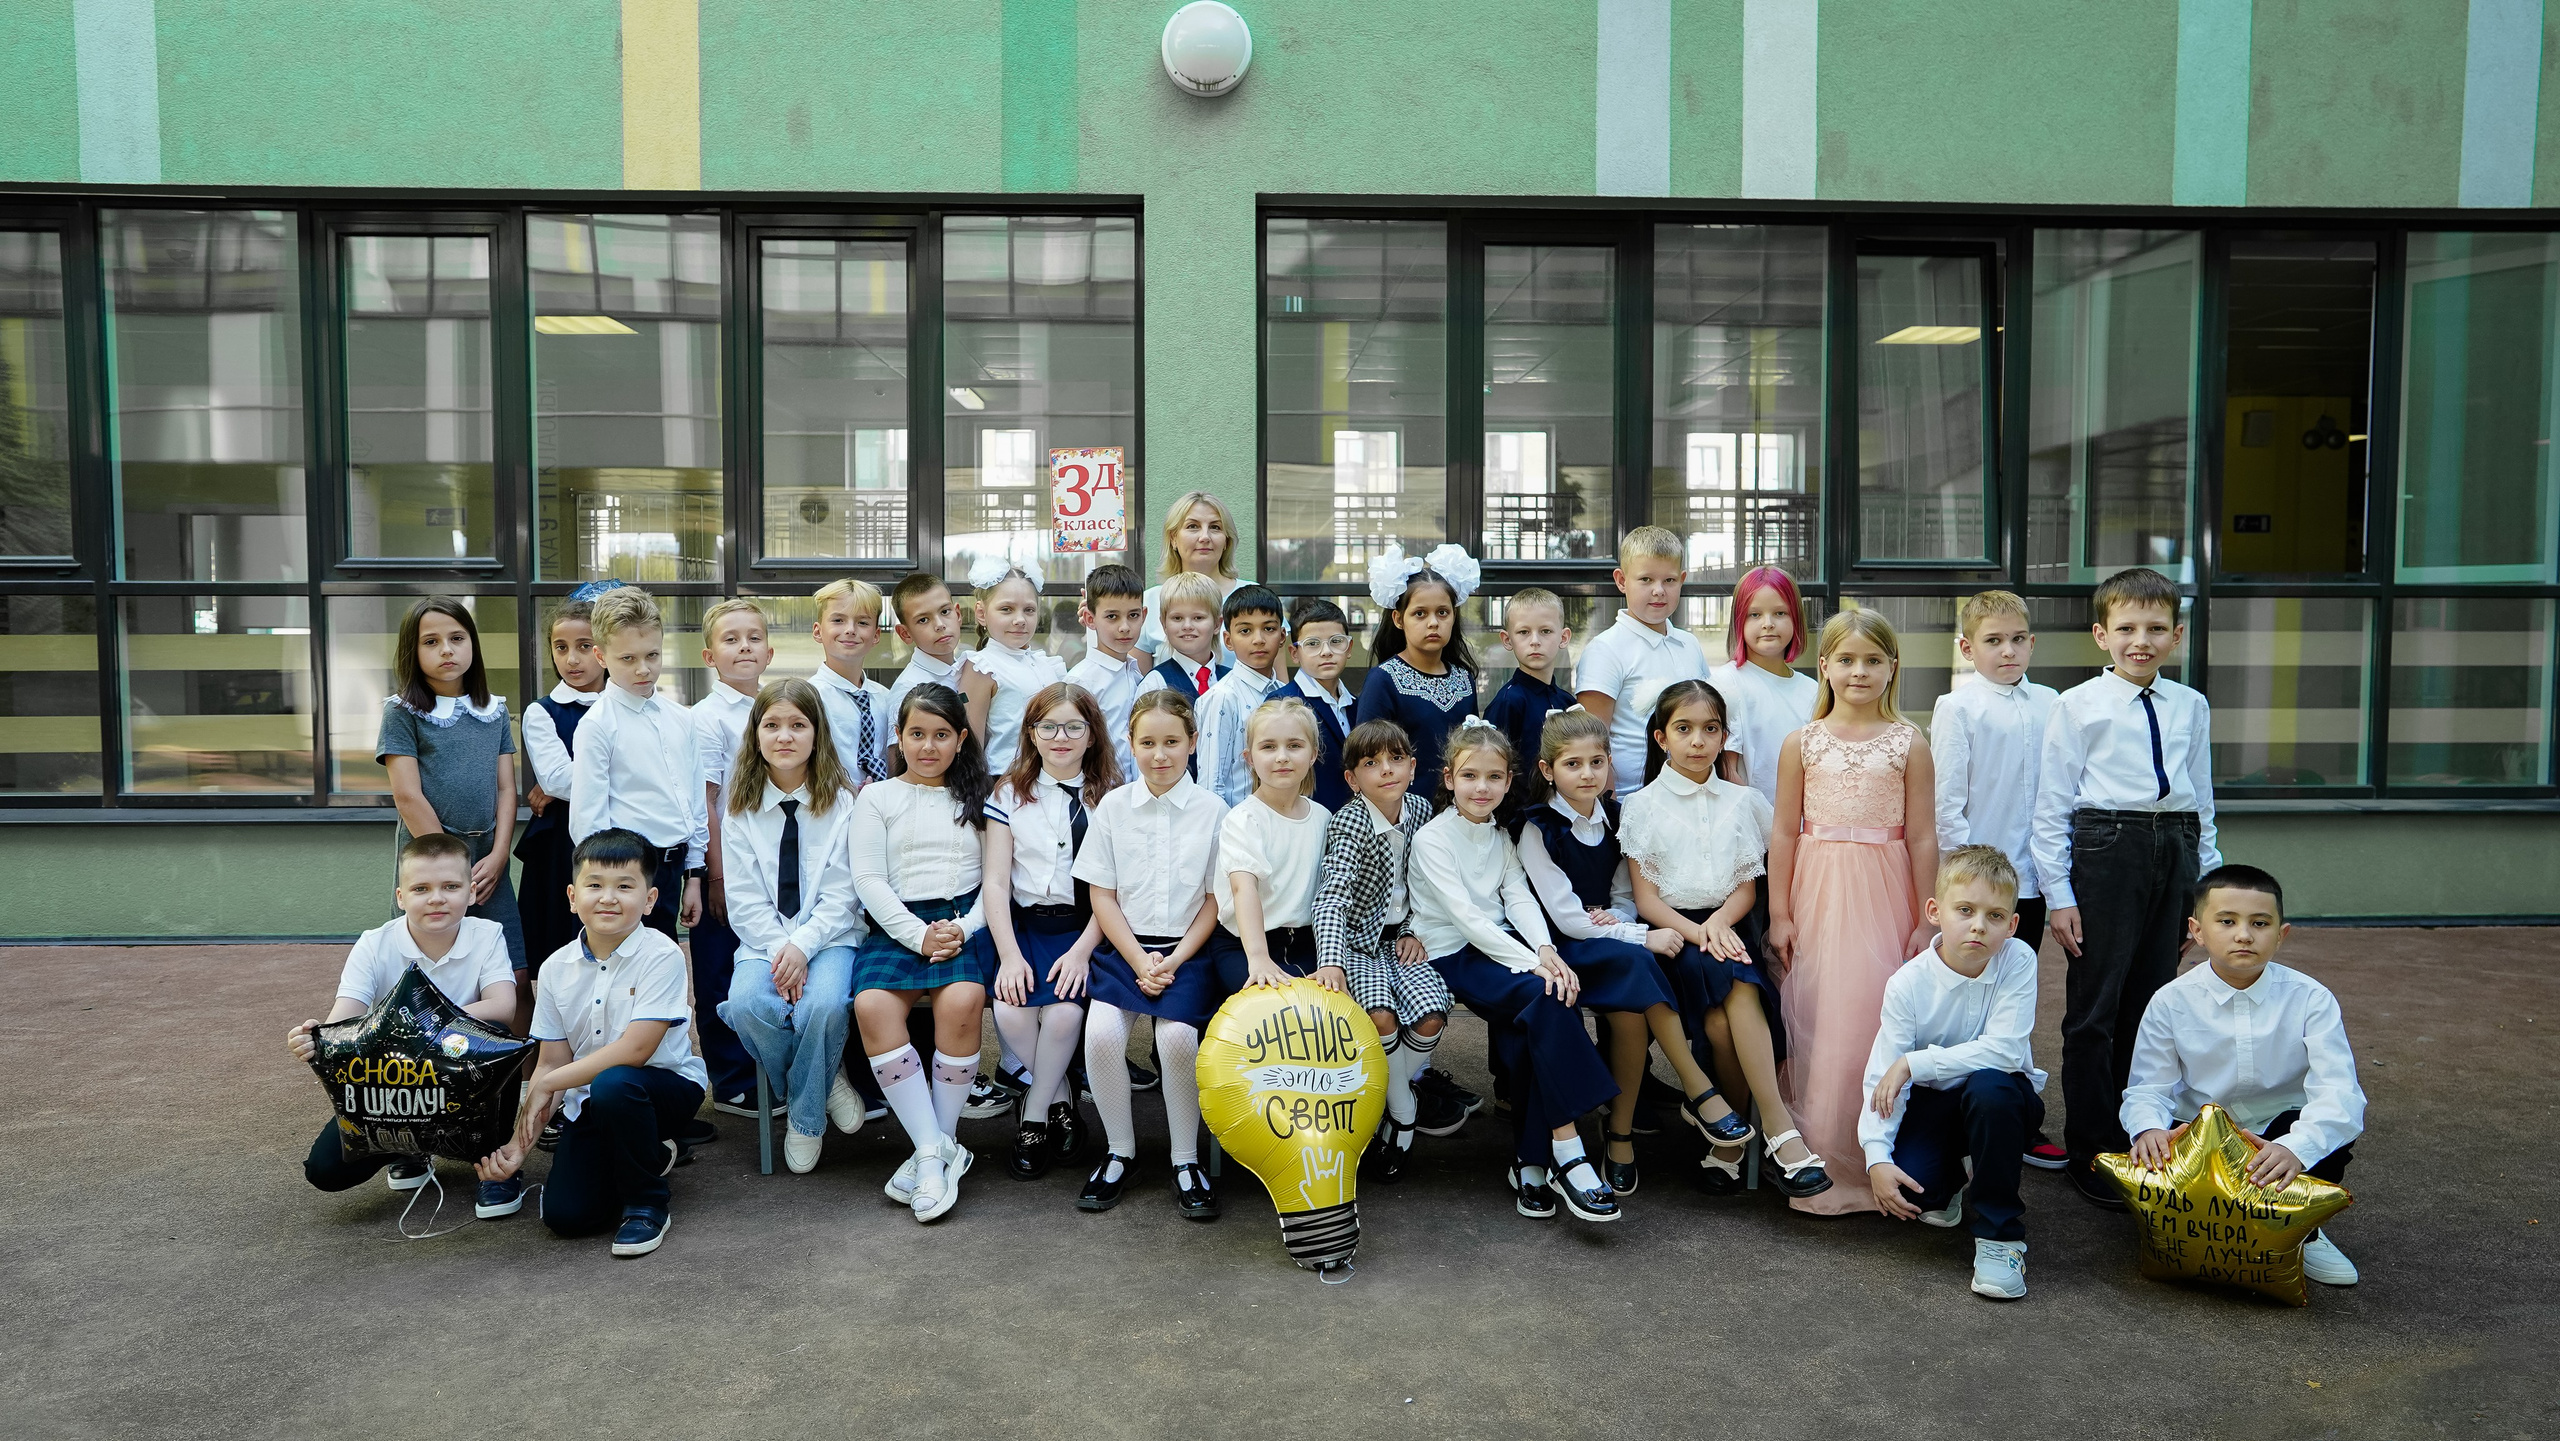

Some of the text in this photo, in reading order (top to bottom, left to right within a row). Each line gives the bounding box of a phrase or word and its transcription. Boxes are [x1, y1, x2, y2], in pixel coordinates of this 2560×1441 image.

[1063, 518, 1116, 531] класс
[348, 1056, 438, 1086] СНОВА
[1281, 1067, 1335, 1092] это
[344, 1083, 447, 1116] В ШКОЛУ!
[2138, 1170, 2292, 1227] БУДЬ ЛУЧШЕ,
[2140, 1208, 2259, 1248] ЧЕМ ВЧЕРА,
[2166, 1236, 2188, 1258] НЕ
[2204, 1245, 2284, 1266] ЛУЧШЕ,
[2196, 1264, 2274, 1284] ДРУГИЕ
